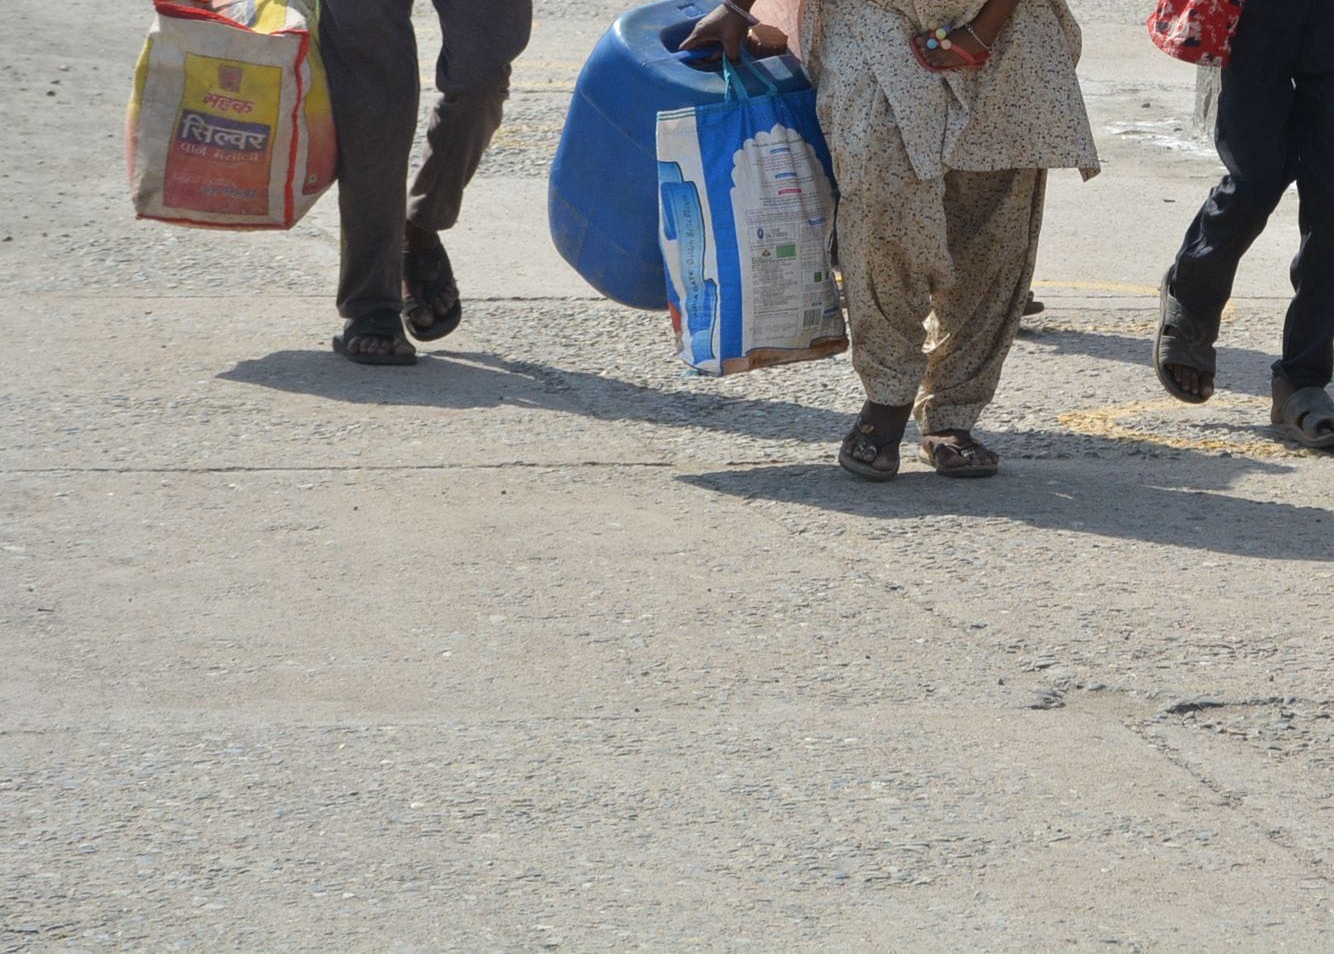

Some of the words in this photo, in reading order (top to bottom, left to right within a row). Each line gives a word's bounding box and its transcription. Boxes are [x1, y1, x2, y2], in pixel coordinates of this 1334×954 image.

[202, 92, 255, 114] महक
[182, 114, 266, 150] सिल्वर
[180, 142, 208, 157] पान
